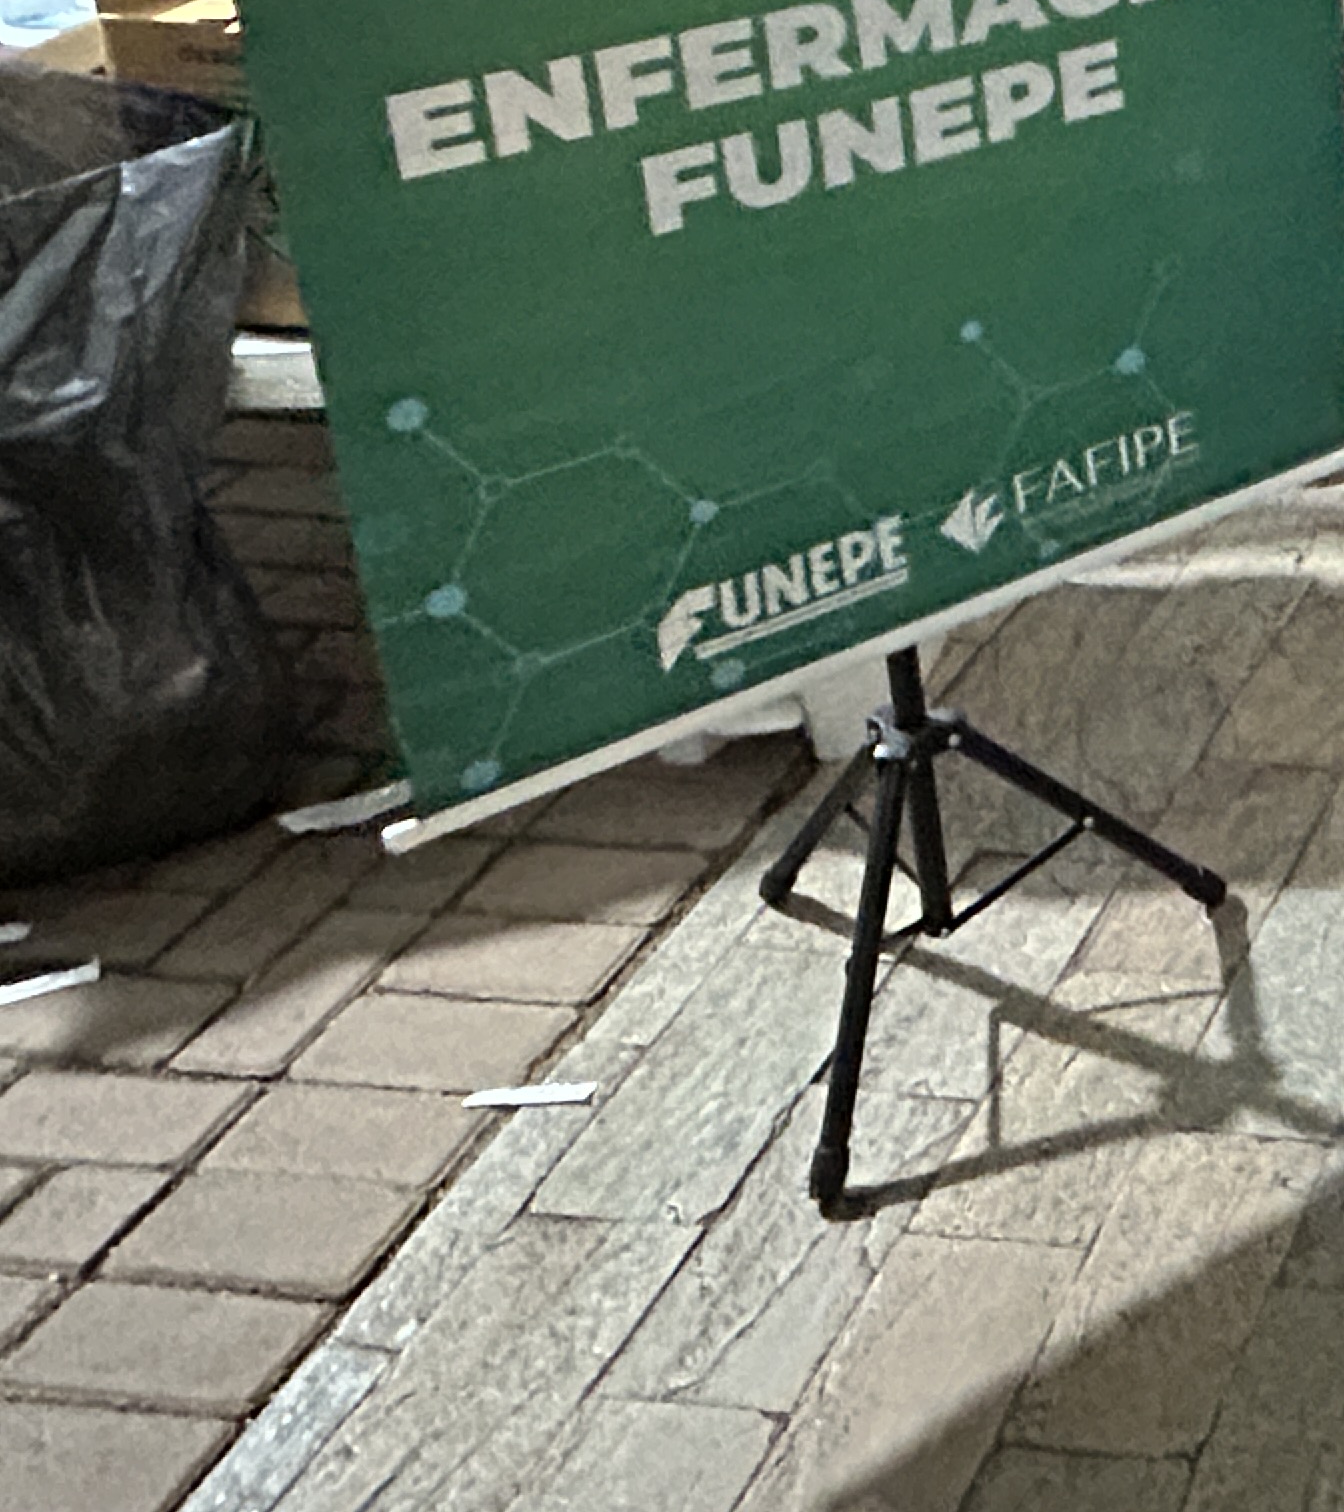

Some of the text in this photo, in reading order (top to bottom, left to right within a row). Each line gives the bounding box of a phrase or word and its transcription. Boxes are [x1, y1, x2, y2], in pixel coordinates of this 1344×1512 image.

[640, 38, 1125, 236] FUNEPE
[1013, 411, 1200, 513] FAFIPE
[657, 514, 908, 673] FUNEPE
